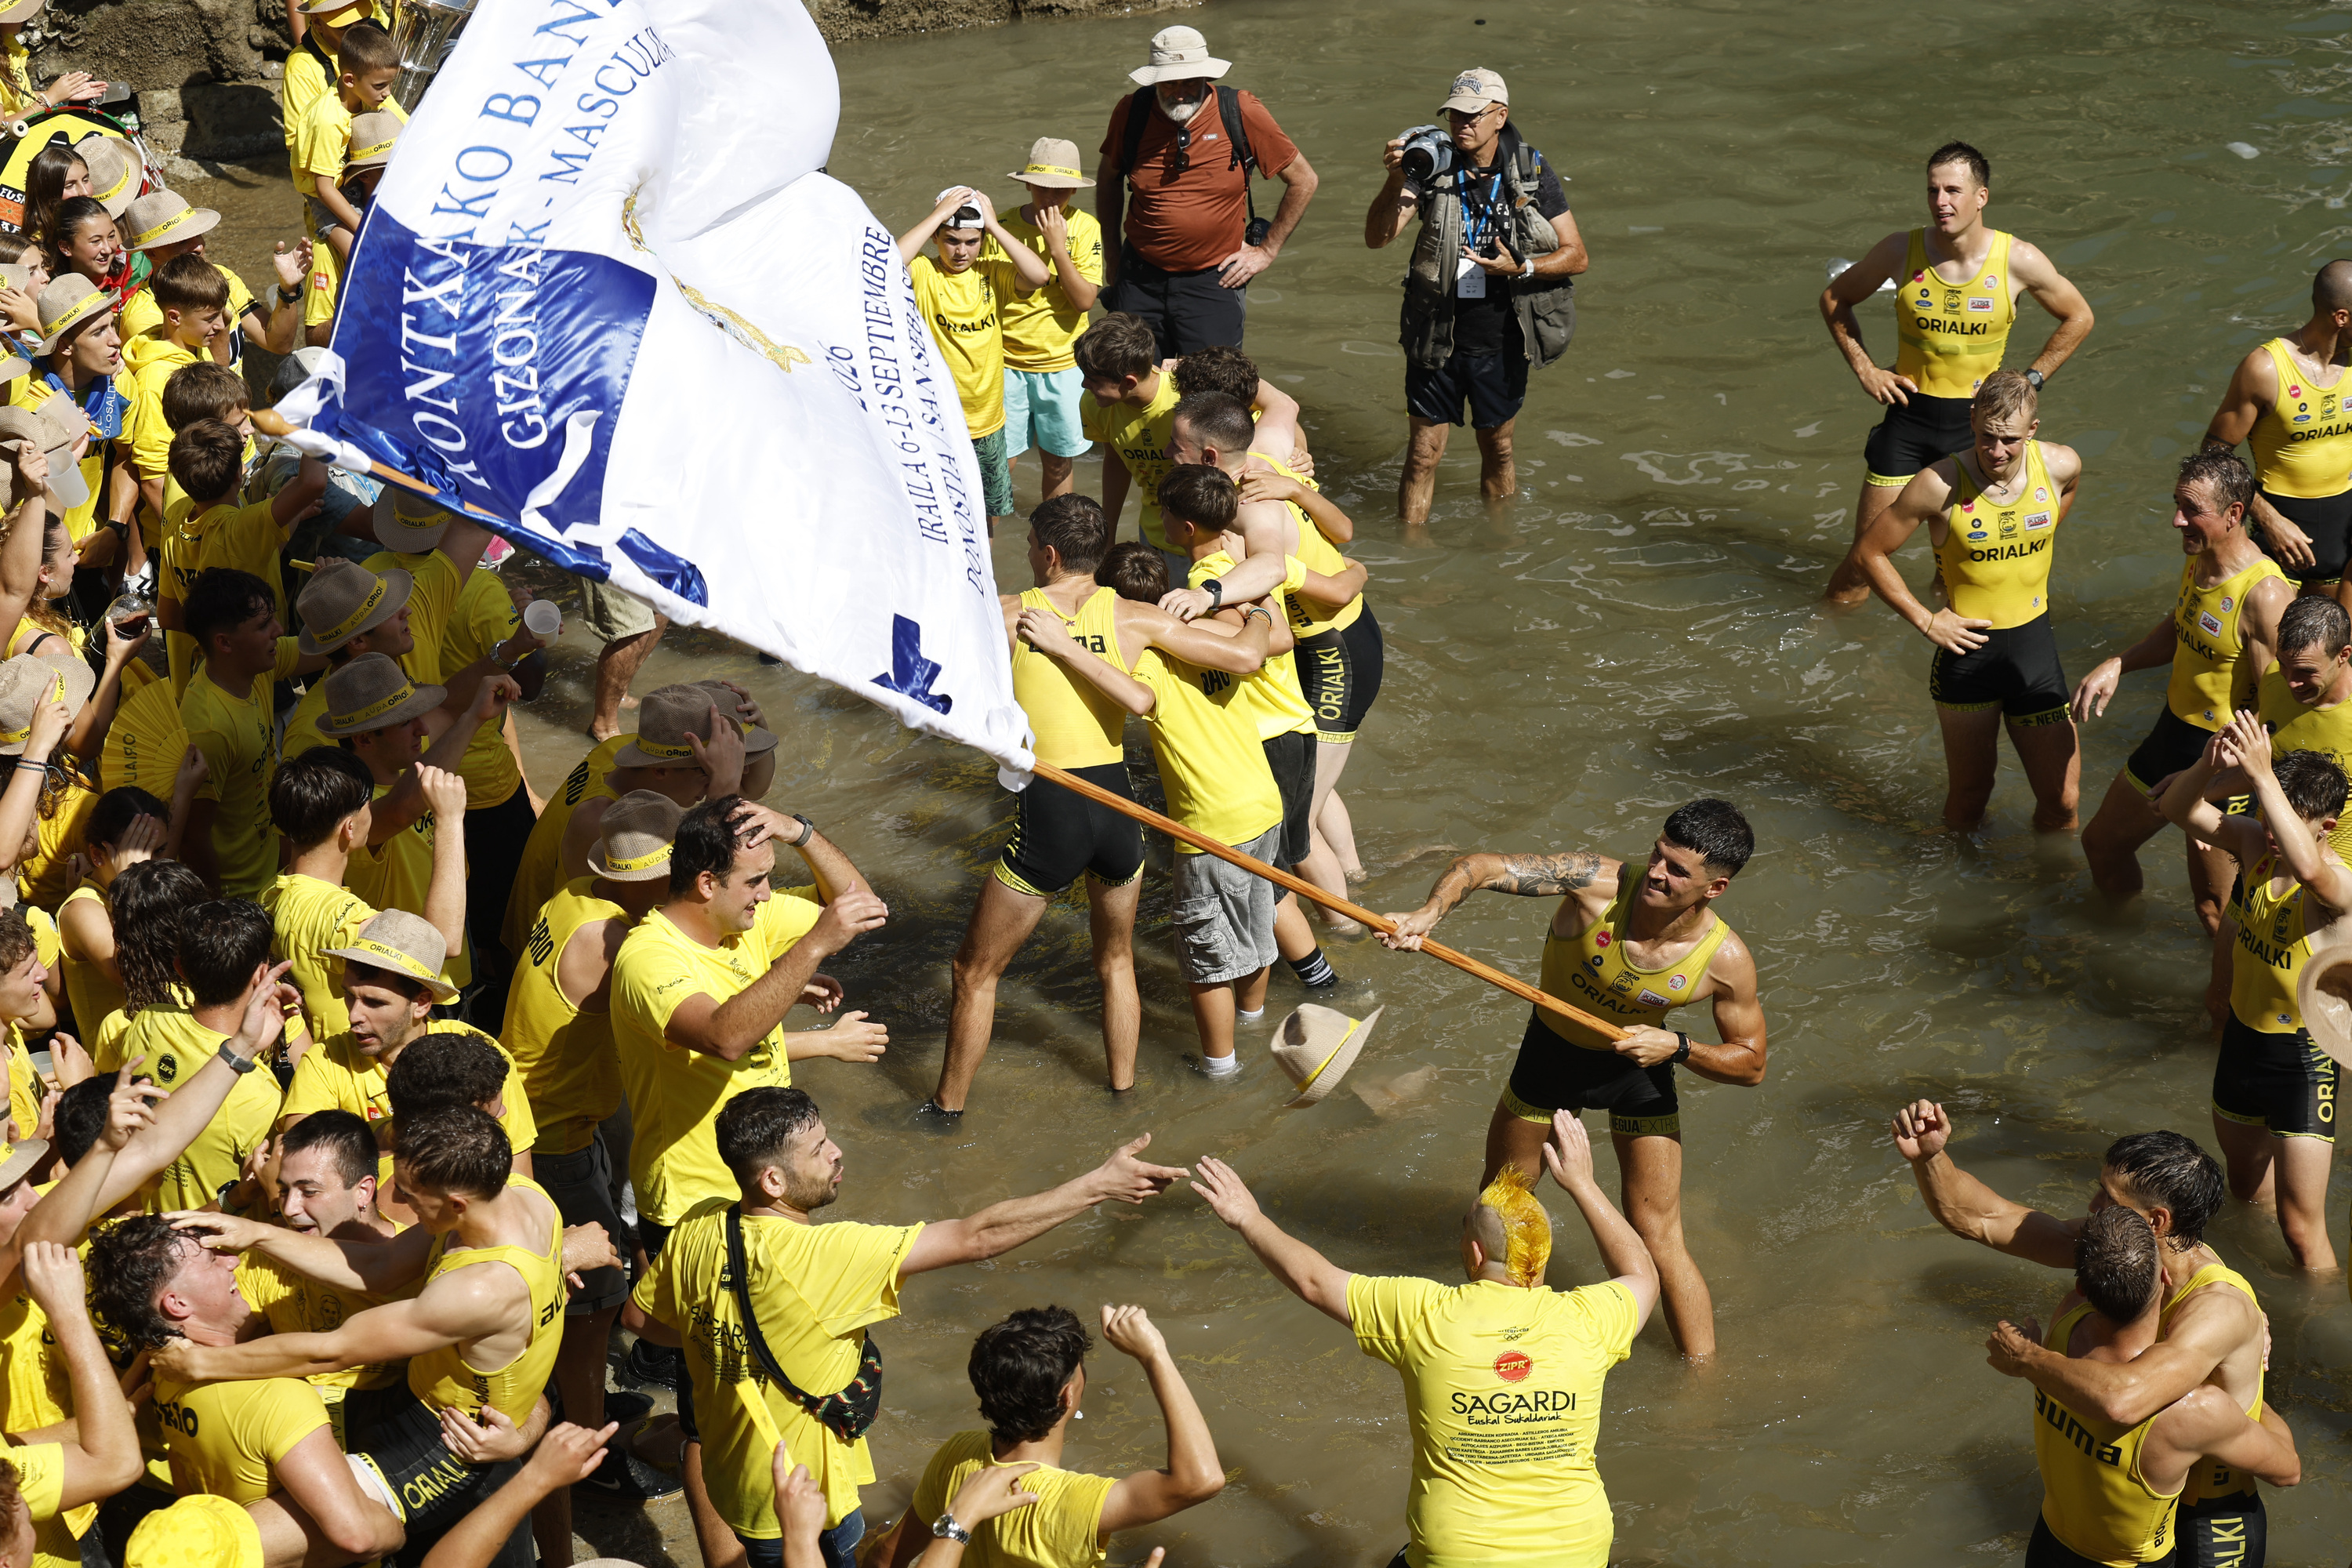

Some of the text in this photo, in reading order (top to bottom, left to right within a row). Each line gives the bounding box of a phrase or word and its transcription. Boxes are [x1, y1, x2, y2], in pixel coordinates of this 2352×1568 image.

[479, 0, 623, 127] BAN
[373, 141, 393, 152] ORIO!
[93, 193, 111, 201] RIALKI
[162, 217, 181, 230] ORIO!
[59, 307, 80, 325] ORIALKI
[862, 227, 904, 399] SEPTIEMBRE
[493, 220, 552, 448] GIZONAK
[1917, 317, 1987, 335] ORIALKI
[913, 366, 944, 432] SAN
[1123, 448, 1171, 461] ORIAL
[900, 461, 949, 545] IRAILA
[401, 514, 452, 527] ORIALKI AUP
[938, 452, 985, 598] DONOSTIA
[1969, 539, 2046, 562] ORIALKI
[319, 586, 383, 642] ORIALKI AUPA ORIO!
[2176, 624, 2213, 660] RIALKI
[1316, 647, 1345, 720] ORIALKI
[335, 690, 408, 726] ORIALKI AUPA ORIO!
[645, 746, 691, 757] AUPA ORIO!
[609, 853, 667, 870] ORIALKI AUPA
[370, 944, 402, 961] ORIALKI
[1452, 1391, 1576, 1414] SAGARDI
[1468, 1412, 1562, 1425] Euskal Sukaldariak
